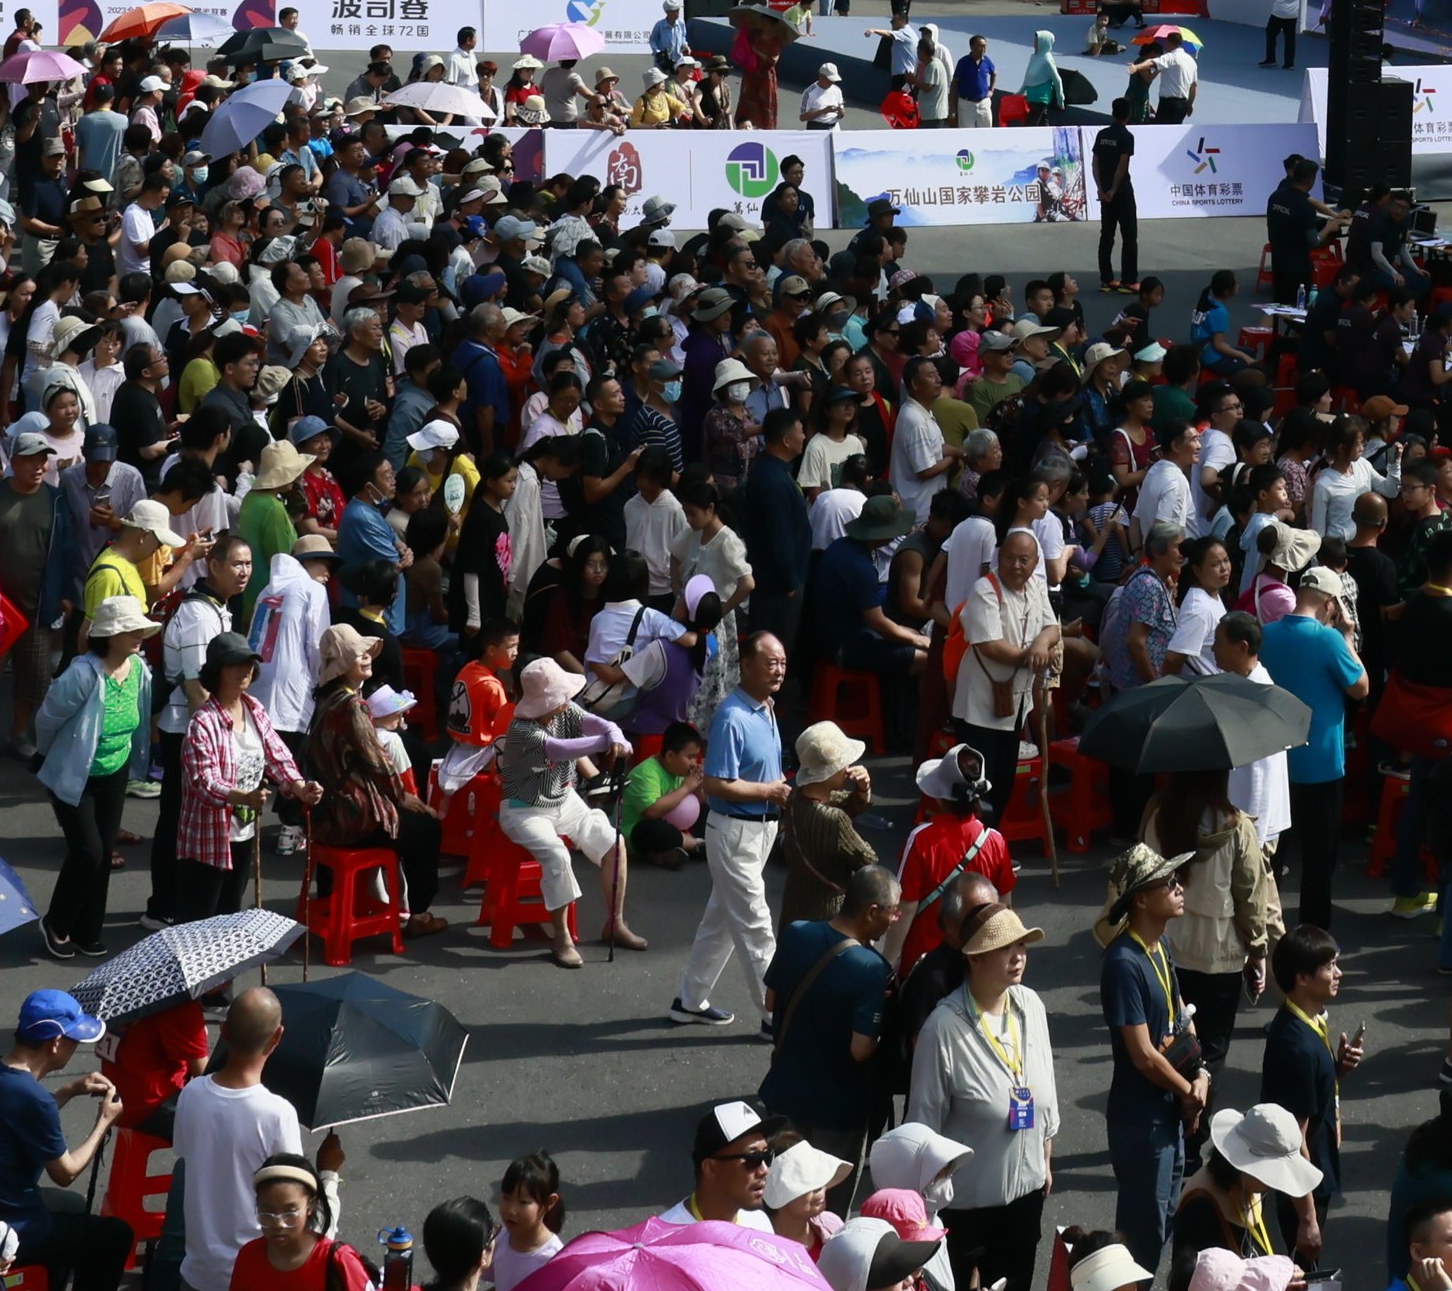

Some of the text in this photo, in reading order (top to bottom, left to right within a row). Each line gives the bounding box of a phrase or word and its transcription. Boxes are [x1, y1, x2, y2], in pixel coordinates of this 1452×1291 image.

[330, 24, 429, 37] 畅销全球72国
[887, 182, 1041, 207] 万仙山国家攀岩公园
[1170, 182, 1244, 198] 中国体育彩票
